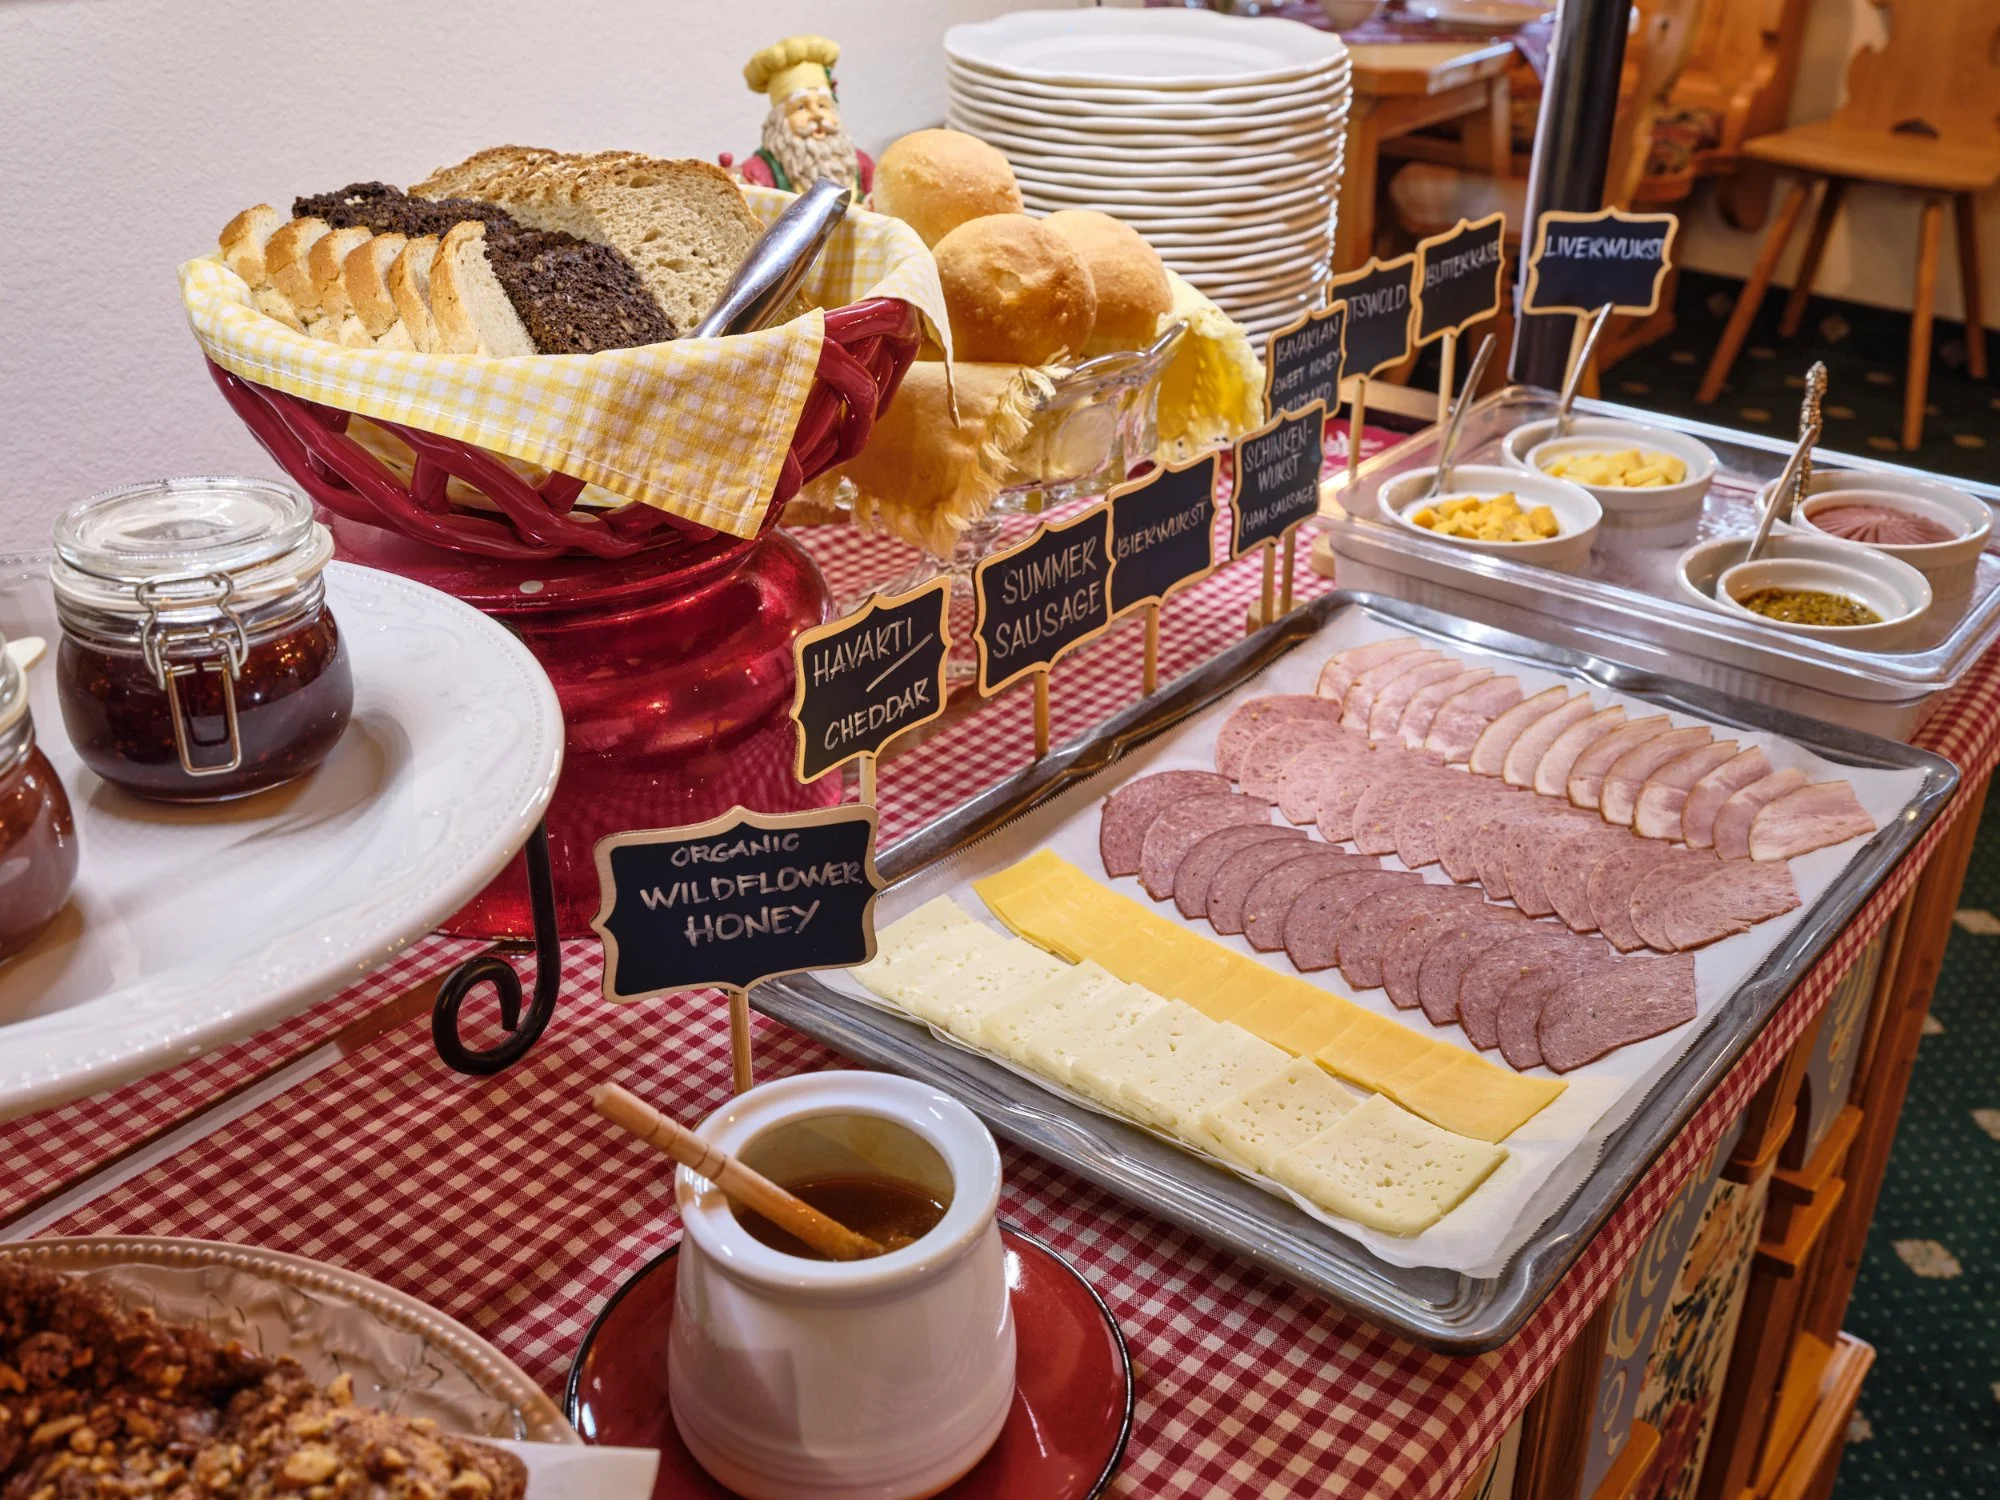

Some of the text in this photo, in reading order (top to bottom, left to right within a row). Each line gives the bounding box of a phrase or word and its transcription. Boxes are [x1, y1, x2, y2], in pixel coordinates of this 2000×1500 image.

[1545, 235, 1665, 260] LIVERWURST
[1347, 284, 1408, 324] TSWOLD
[1276, 316, 1339, 366] BAVARIAN
[1274, 348, 1340, 396] SWEET HONEY
[1258, 453, 1302, 493] WURST
[1115, 498, 1211, 564] BIERWURST
[1240, 478, 1318, 537] (HAM SAUSAGE)
[1001, 535, 1097, 605] SUMMER
[992, 581, 1101, 660] SAUSAGE
[813, 617, 913, 687] HAVARTI
[824, 678, 930, 751] CHEDDAR
[671, 832, 800, 867] ORGANIC
[640, 861, 863, 912] WILDFLOWER
[684, 900, 820, 948] HONEY
